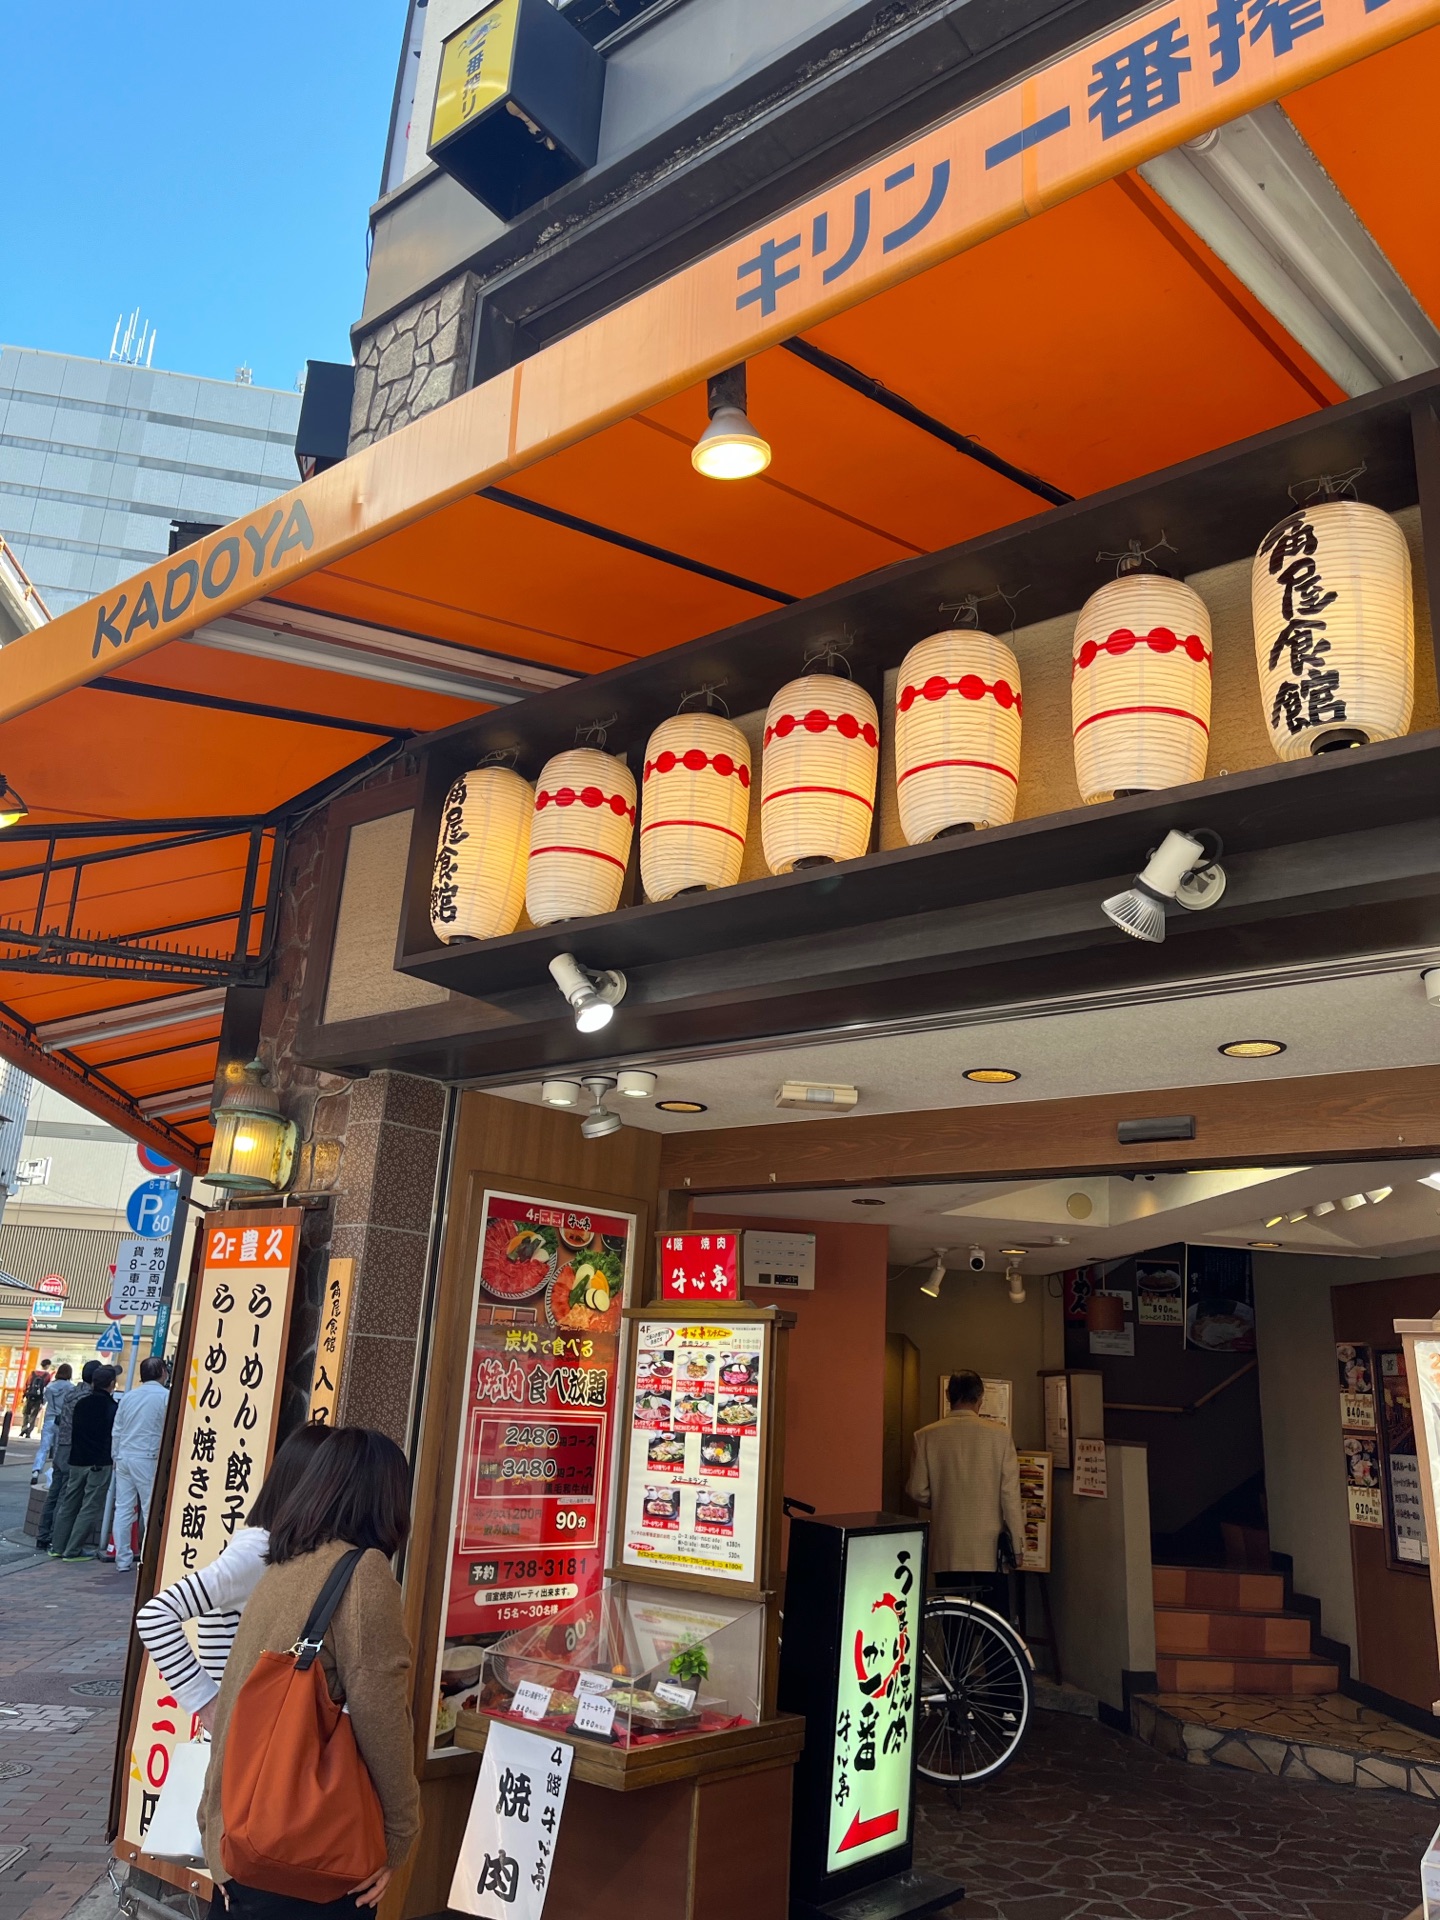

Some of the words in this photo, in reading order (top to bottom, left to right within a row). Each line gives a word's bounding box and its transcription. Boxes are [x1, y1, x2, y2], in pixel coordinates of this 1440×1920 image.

[460, 41, 484, 119] 一番搾り
[736, 158, 951, 318] キリン
[985, 0, 1390, 171] 一番搾
[92, 499, 314, 658] KADOYA
[1259, 511, 1348, 735] 角屋食館
[137, 1194, 162, 1230] P
[152, 1208, 175, 1232] 60
[526, 1208, 540, 1221] 4F
[133, 1246, 164, 1257] 貨物
[211, 1231, 236, 1260] 2F
[238, 1229, 284, 1262] 豊久
[666, 1238, 683, 1251] 4階
[701, 1237, 726, 1250] 焼肉
[129, 1273, 160, 1284] 車両
[323, 1280, 341, 1354] 角屋食館
[640, 1325, 650, 1333] 4F
[504, 1330, 594, 1358] 炭火で食べる
[476, 1358, 608, 1407] 焼肉食べ放題
[179, 1283, 235, 1580] らーめん・焼き飯セ
[219, 1283, 272, 1556] らーめん・餃子
[673, 1475, 708, 1485] ステーキランチ
[556, 1511, 587, 1529] 90分
[472, 1565, 495, 1581] 予約
[503, 1557, 587, 1579] 738-3181
[883, 1551, 913, 1754] うまい焼肉
[582, 1702, 611, 1715] ステーキランチ
[477, 1767, 532, 1902] 焼肉
